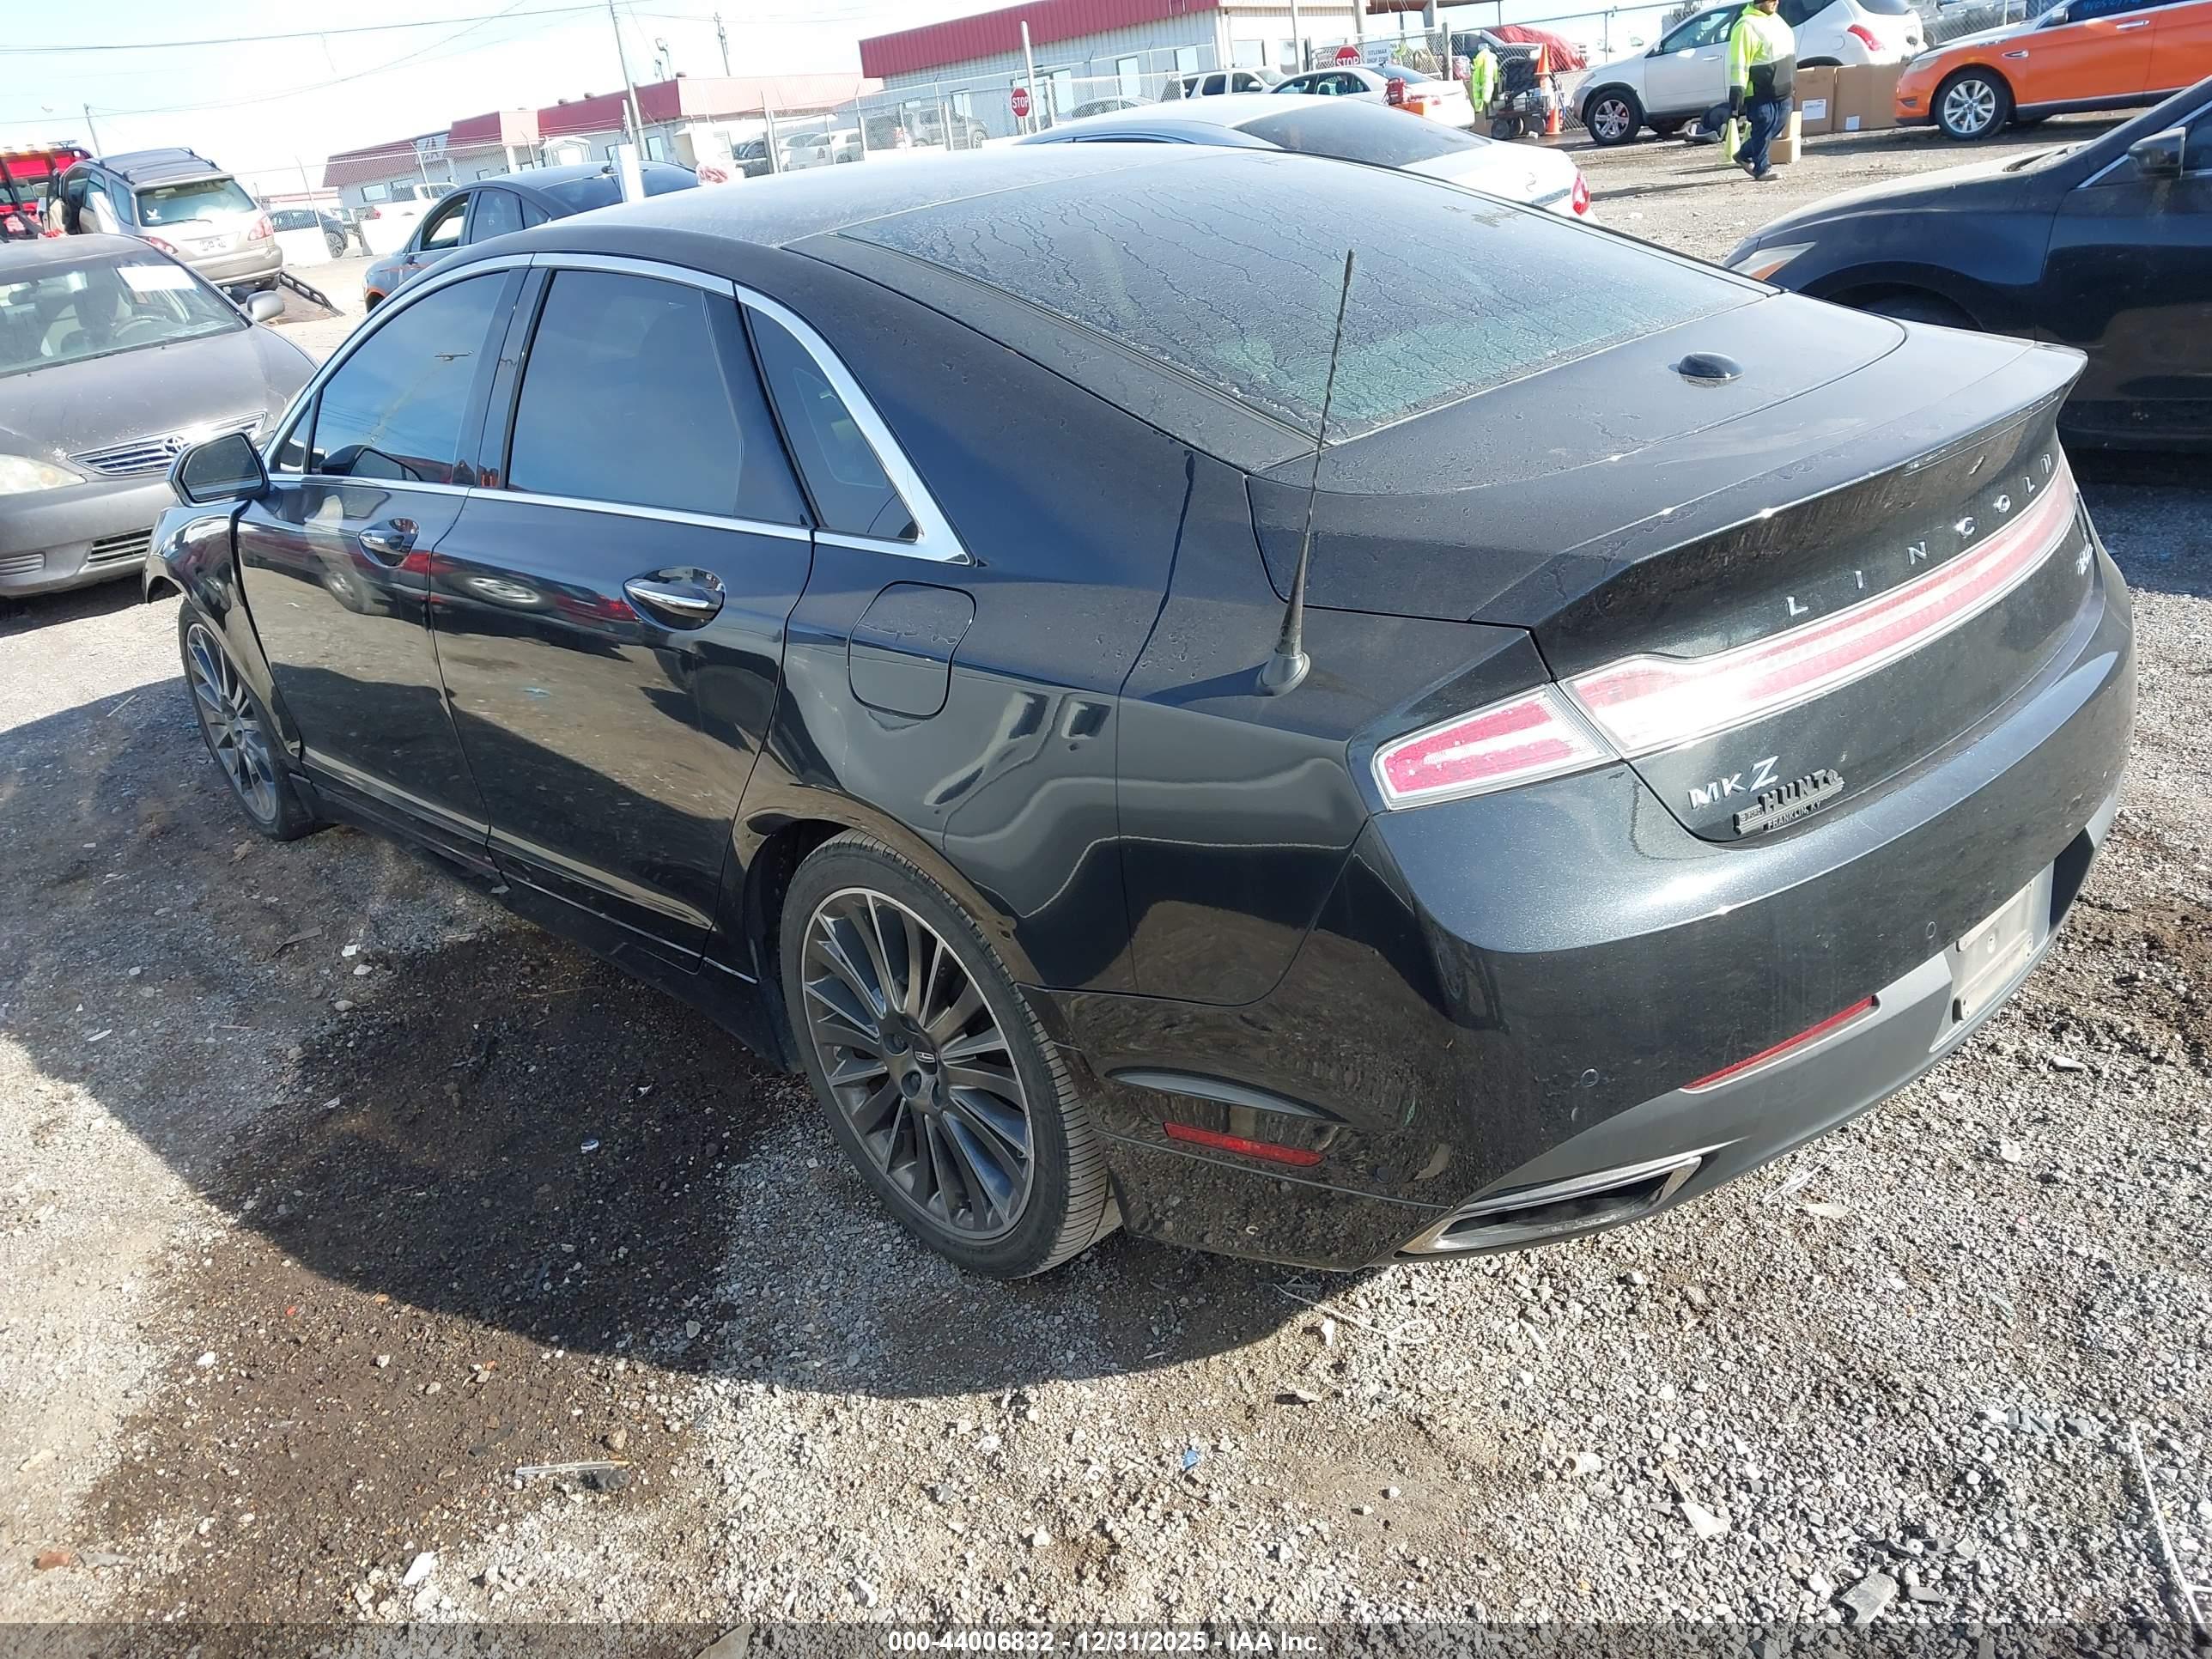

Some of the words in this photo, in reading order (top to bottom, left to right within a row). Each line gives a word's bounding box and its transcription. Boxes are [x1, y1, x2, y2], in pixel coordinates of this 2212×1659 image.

[1337, 56, 1358, 66] STOP
[1012, 96, 1028, 108] STOP
[1687, 755, 1779, 810] MKZ
[1759, 769, 1827, 816] HUNT
[1811, 799, 1821, 811] KY
